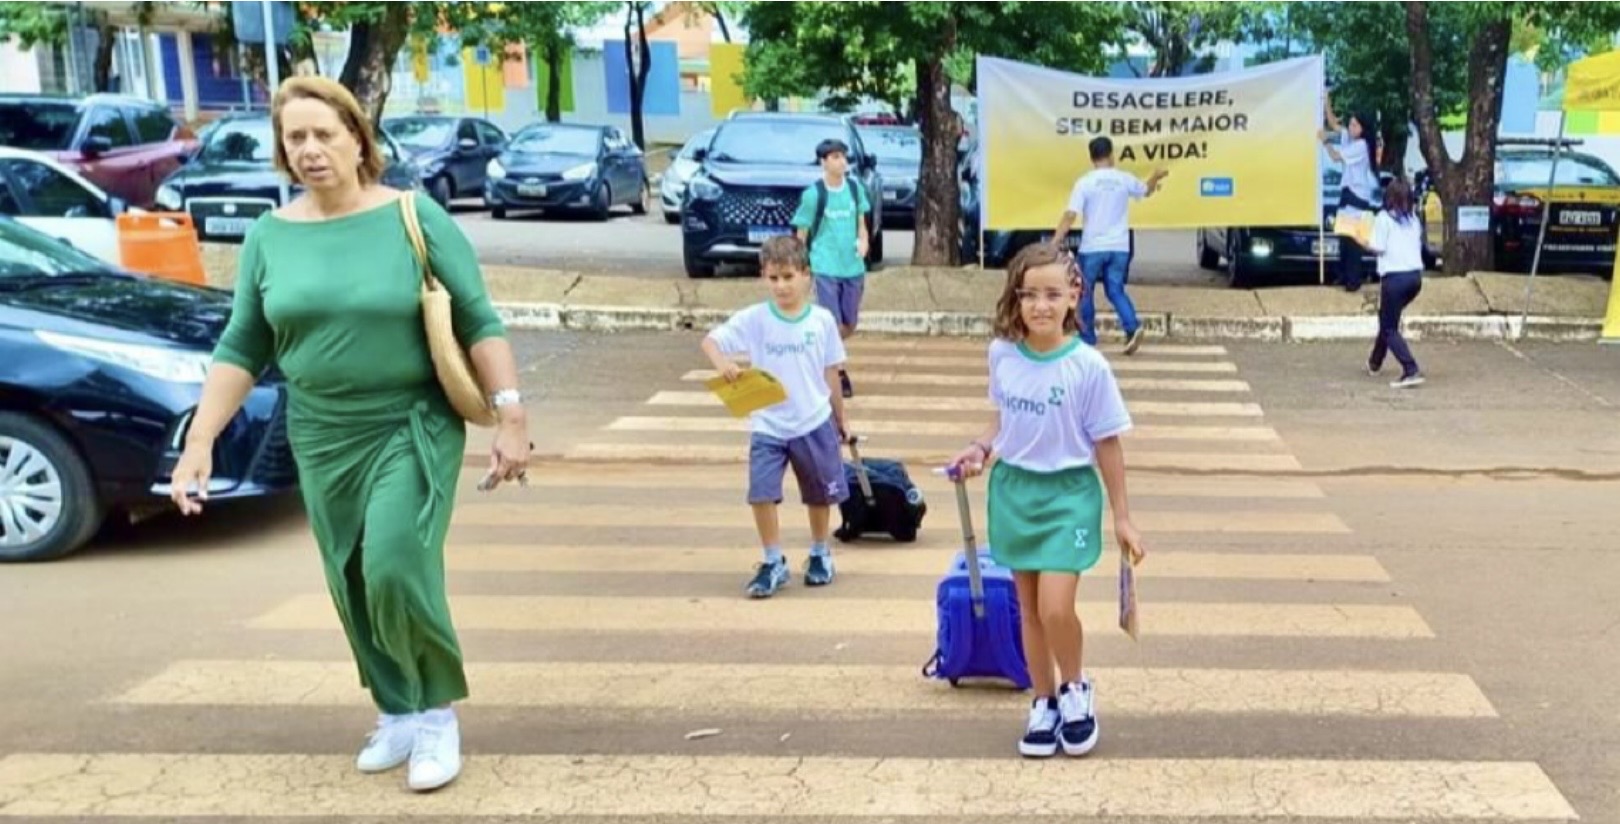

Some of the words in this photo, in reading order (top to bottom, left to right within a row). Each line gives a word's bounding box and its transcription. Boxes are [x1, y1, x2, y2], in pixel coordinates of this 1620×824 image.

[1073, 90, 1234, 108] DESACELERE,
[1056, 118, 1102, 134] SEU
[1111, 119, 1162, 134] BEM
[1170, 113, 1248, 132] MAIOR
[1119, 145, 1136, 161] A
[1143, 141, 1207, 160] VIDA!
